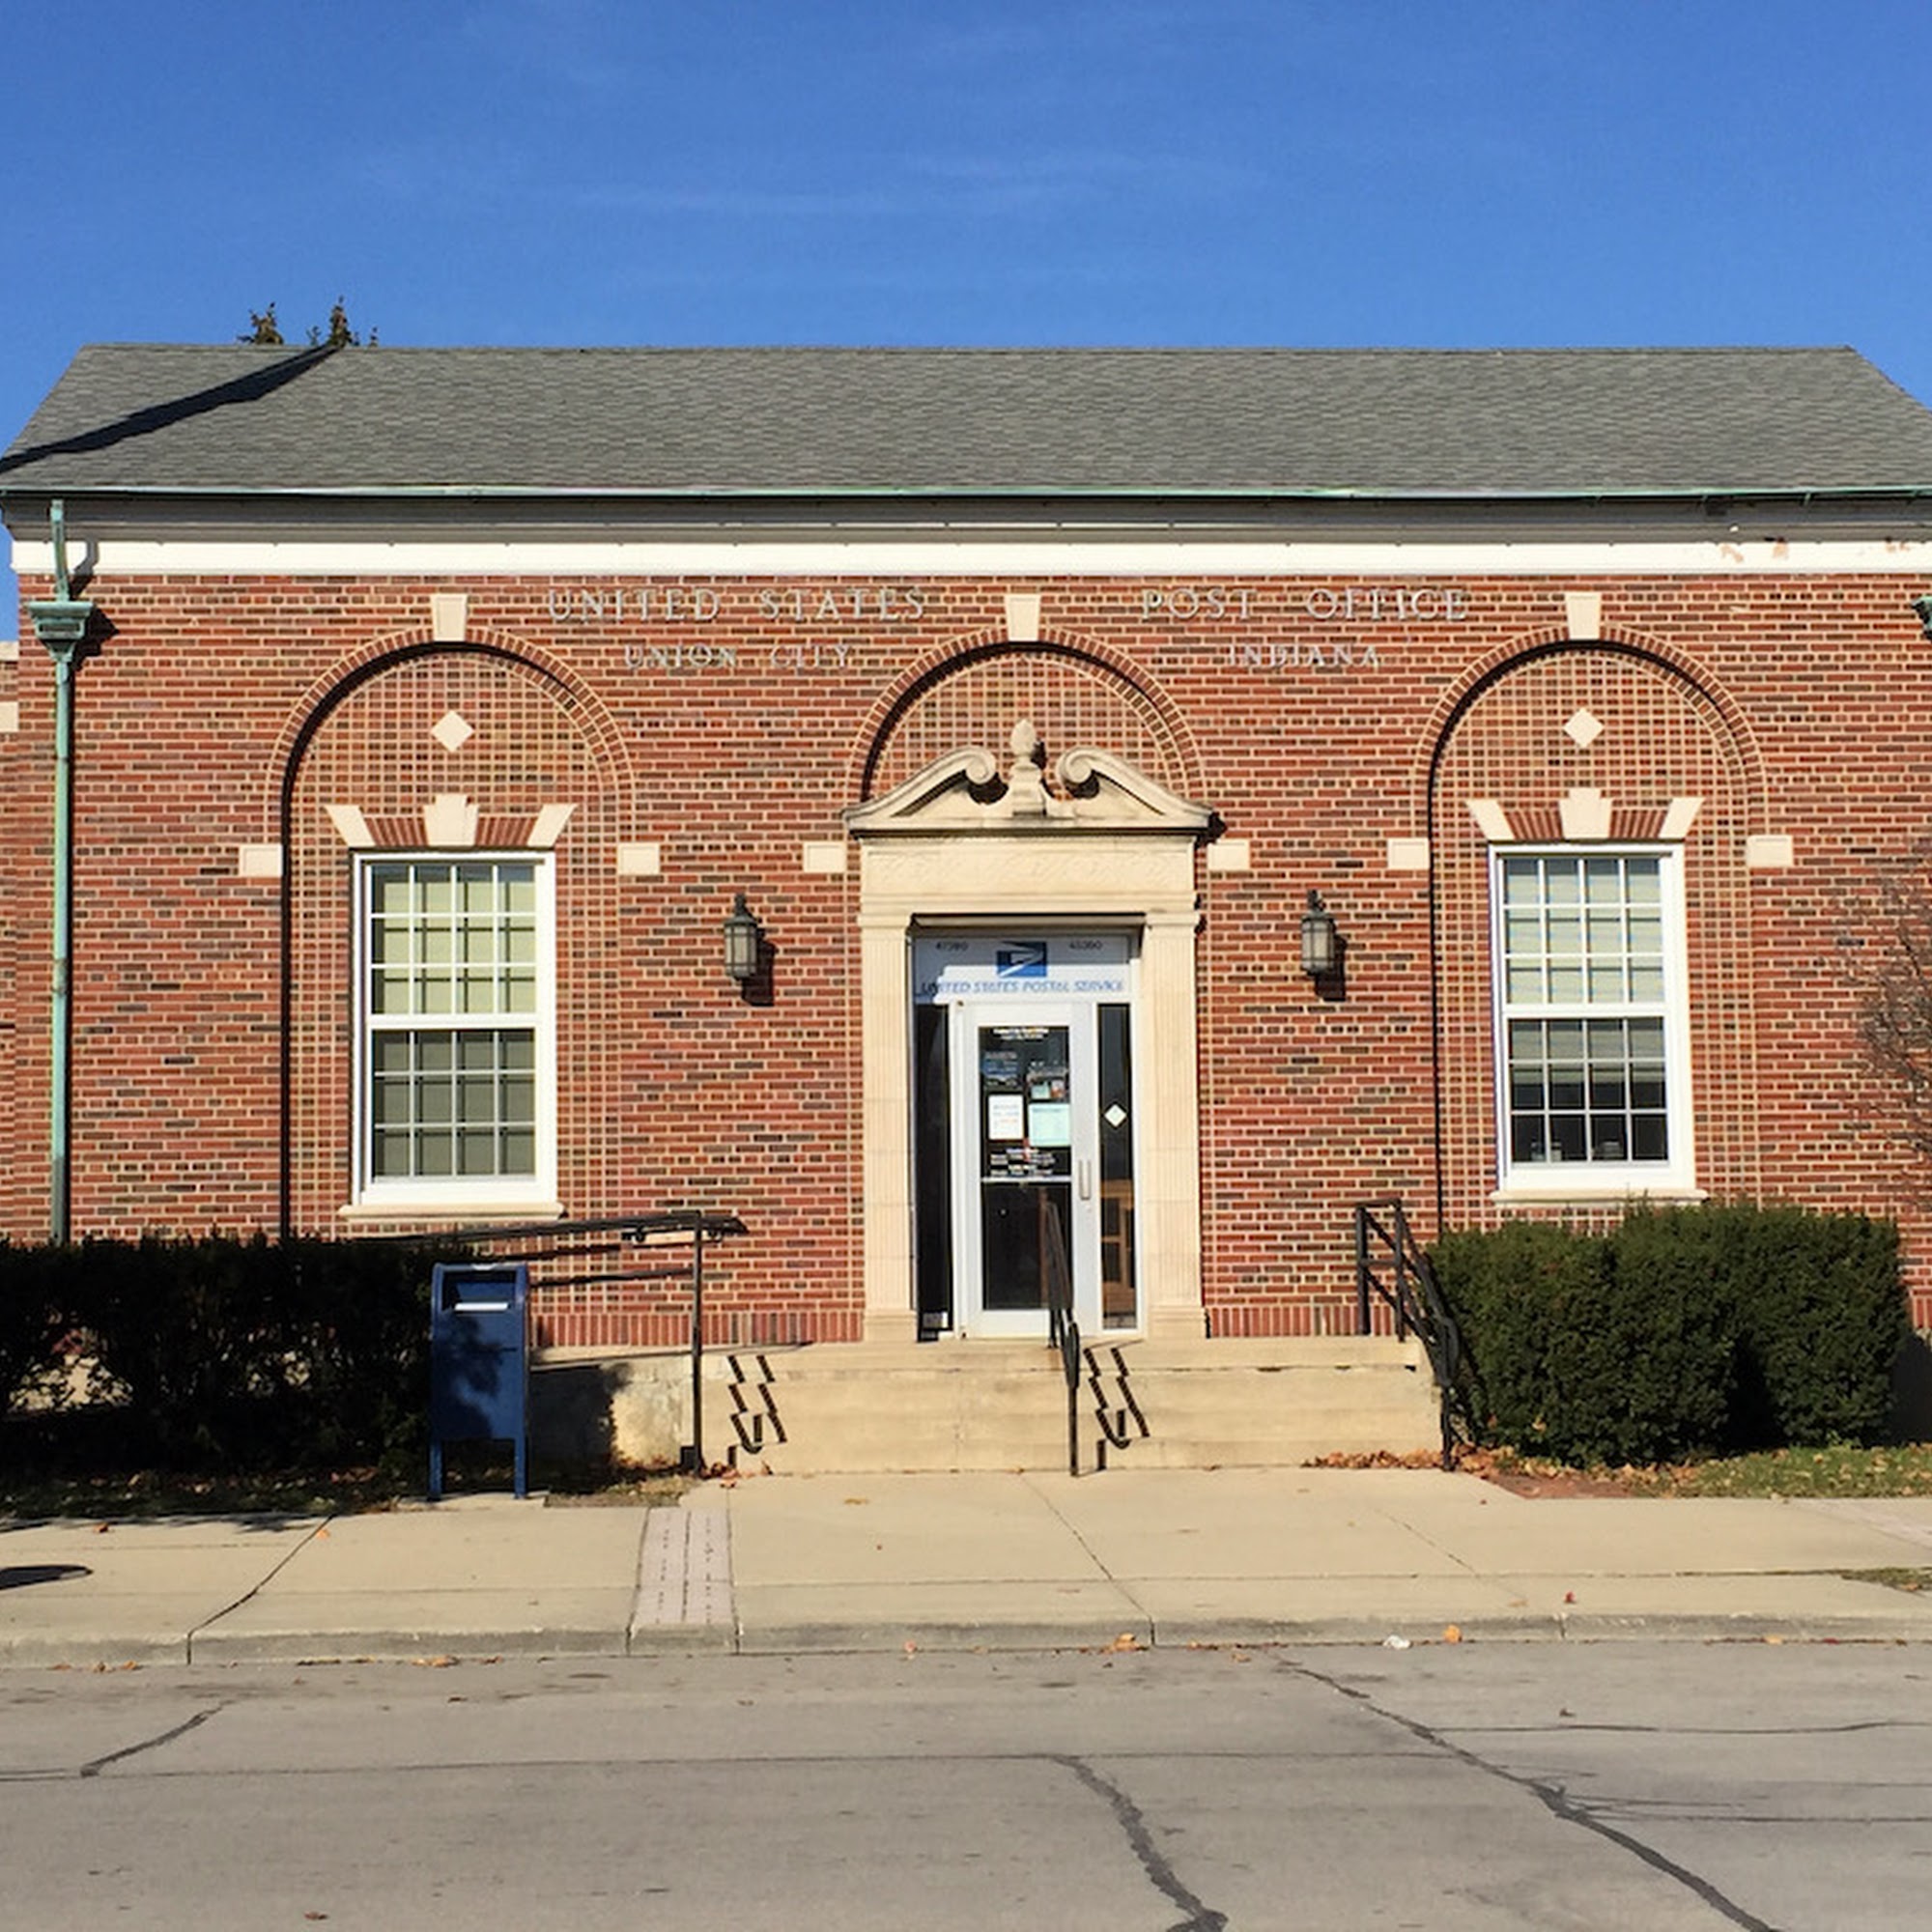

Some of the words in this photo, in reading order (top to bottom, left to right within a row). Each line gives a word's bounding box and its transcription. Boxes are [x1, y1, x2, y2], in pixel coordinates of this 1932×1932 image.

[548, 587, 722, 621] UNITED
[759, 587, 924, 621] STATES
[1142, 587, 1257, 619] POST
[1306, 587, 1467, 620] OFFICE
[623, 644, 737, 668] UNION
[771, 645, 851, 668] CITY
[1228, 644, 1380, 668] INDIANA
[922, 980, 971, 995] UNITED
[974, 980, 1018, 993] STATES
[1023, 980, 1068, 993] POSTAL
[1074, 979, 1123, 992] SERVICE
